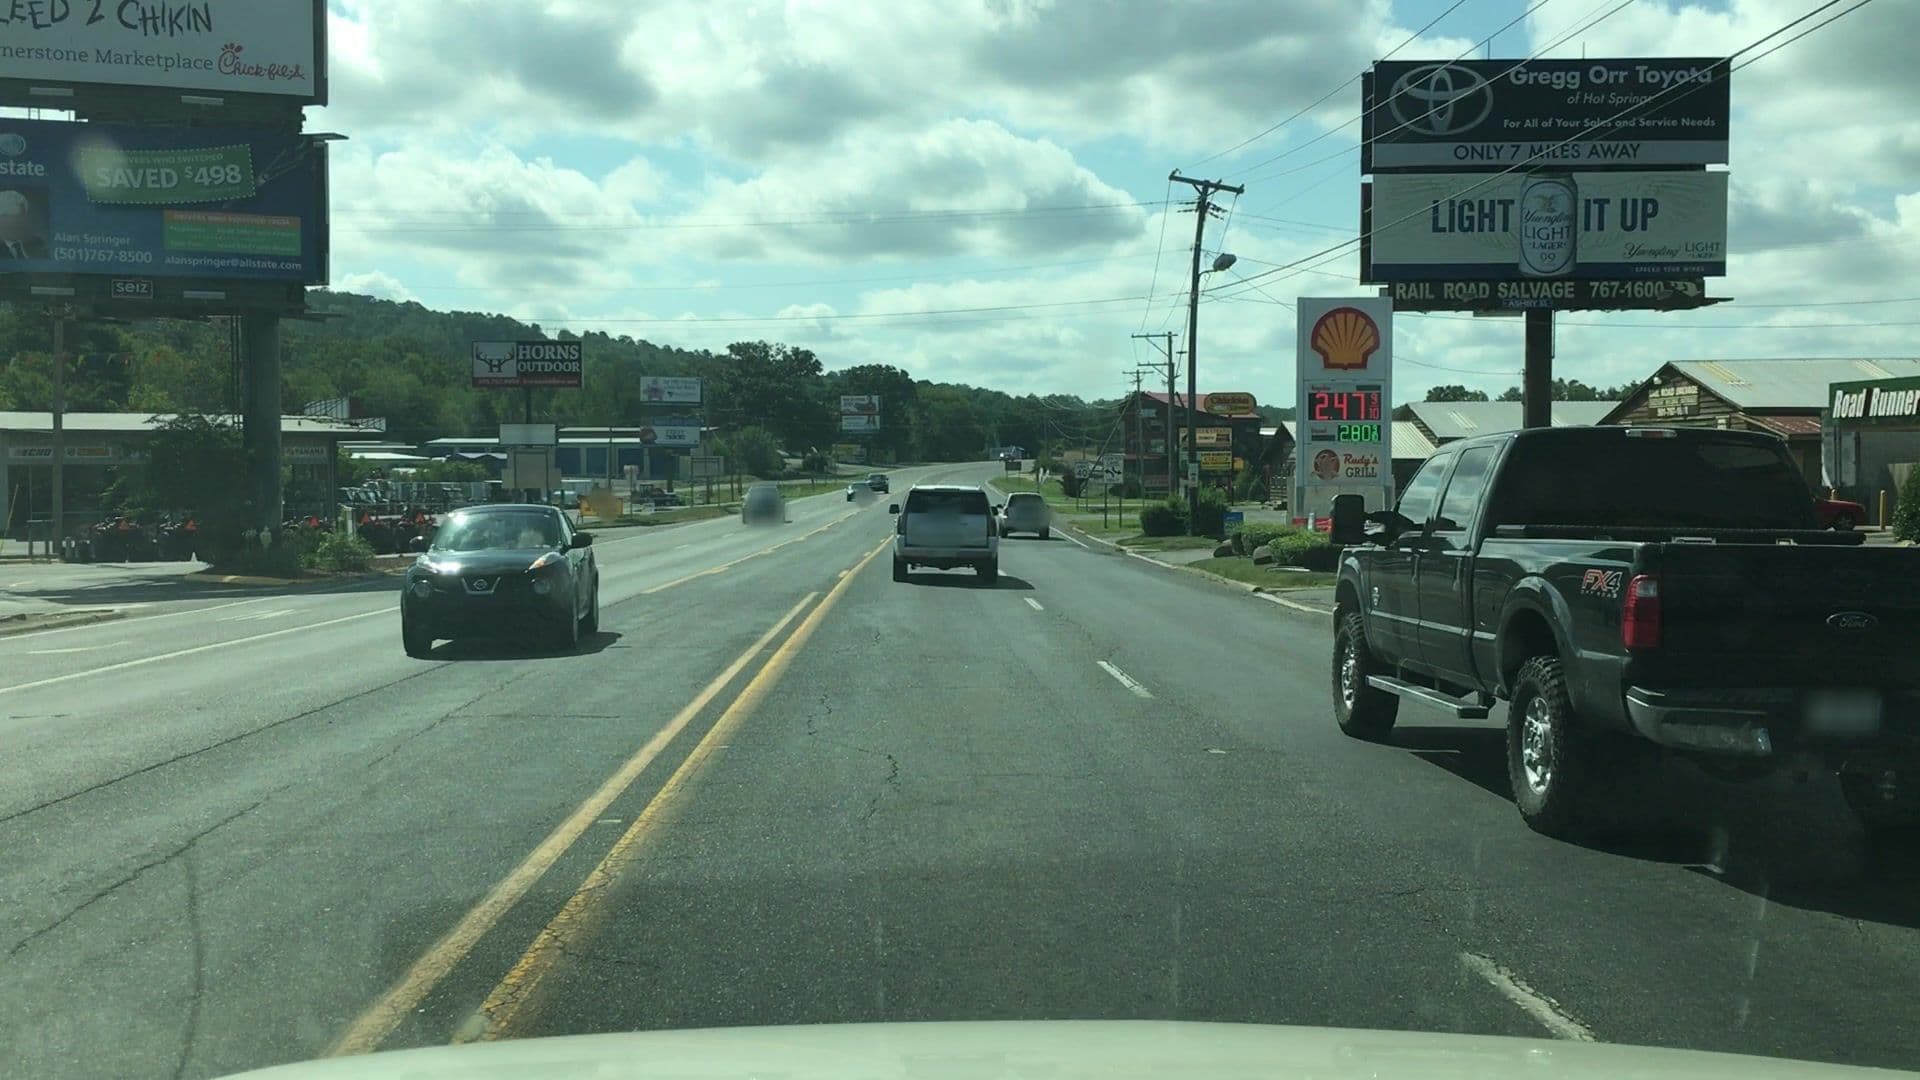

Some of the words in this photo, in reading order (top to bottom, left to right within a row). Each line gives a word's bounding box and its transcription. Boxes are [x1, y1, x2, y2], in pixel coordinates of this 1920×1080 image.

[0, 0, 70, 30] EED
[86, 0, 104, 25] 2
[117, 0, 213, 37] CHIKIN
[0, 45, 88, 63] nerstone
[96, 48, 214, 71] Marketplace
[1509, 65, 1581, 89] Gregg
[1588, 64, 1627, 84] Orr
[1636, 64, 1713, 87] Toyota
[1567, 92, 1580, 105] of
[1583, 93, 1606, 105] Hot
[1609, 92, 1655, 107] Springs
[1504, 118, 1521, 129] For
[1524, 118, 1539, 128] All
[1541, 118, 1553, 128] of
[1556, 118, 1581, 128] Your
[1583, 117, 1611, 128] Sales
[1614, 117, 1636, 128] and
[1639, 117, 1679, 128] Service
[1681, 117, 1716, 127] Needs
[1453, 144, 1504, 161] ONLY
[1510, 144, 1521, 160] 7
[1528, 143, 1581, 160] MILES
[1588, 143, 1641, 159] AWAY
[96, 167, 178, 189] SAVED
[185, 164, 243, 187] $498
[1431, 200, 1515, 233] LIGHT
[1584, 199, 1610, 232] IT
[1620, 198, 1660, 232] UP
[54, 232, 80, 244] Alan
[83, 232, 132, 247] Springer
[1524, 225, 1572, 240] LIGHT
[1684, 241, 1720, 253] LIGHT
[54, 249, 153, 265] (501)767-8500
[165, 256, 302, 272] alanspringer@allstate.com
[1396, 283, 1435, 300] RAIL
[1444, 282, 1489, 299] ROAD
[1498, 282, 1575, 299] SALVAGE
[1589, 281, 1664, 299] 767-1600
[517, 344, 579, 360] HORNS
[517, 361, 581, 373] OUTDOOR
[1315, 391, 1366, 420] 2.47
[1832, 388, 1867, 418] Road
[1869, 387, 1920, 417] Runner
[1343, 453, 1379, 466] Rudy's
[1345, 466, 1378, 478] GRILL
[1582, 568, 1624, 592] FX4
